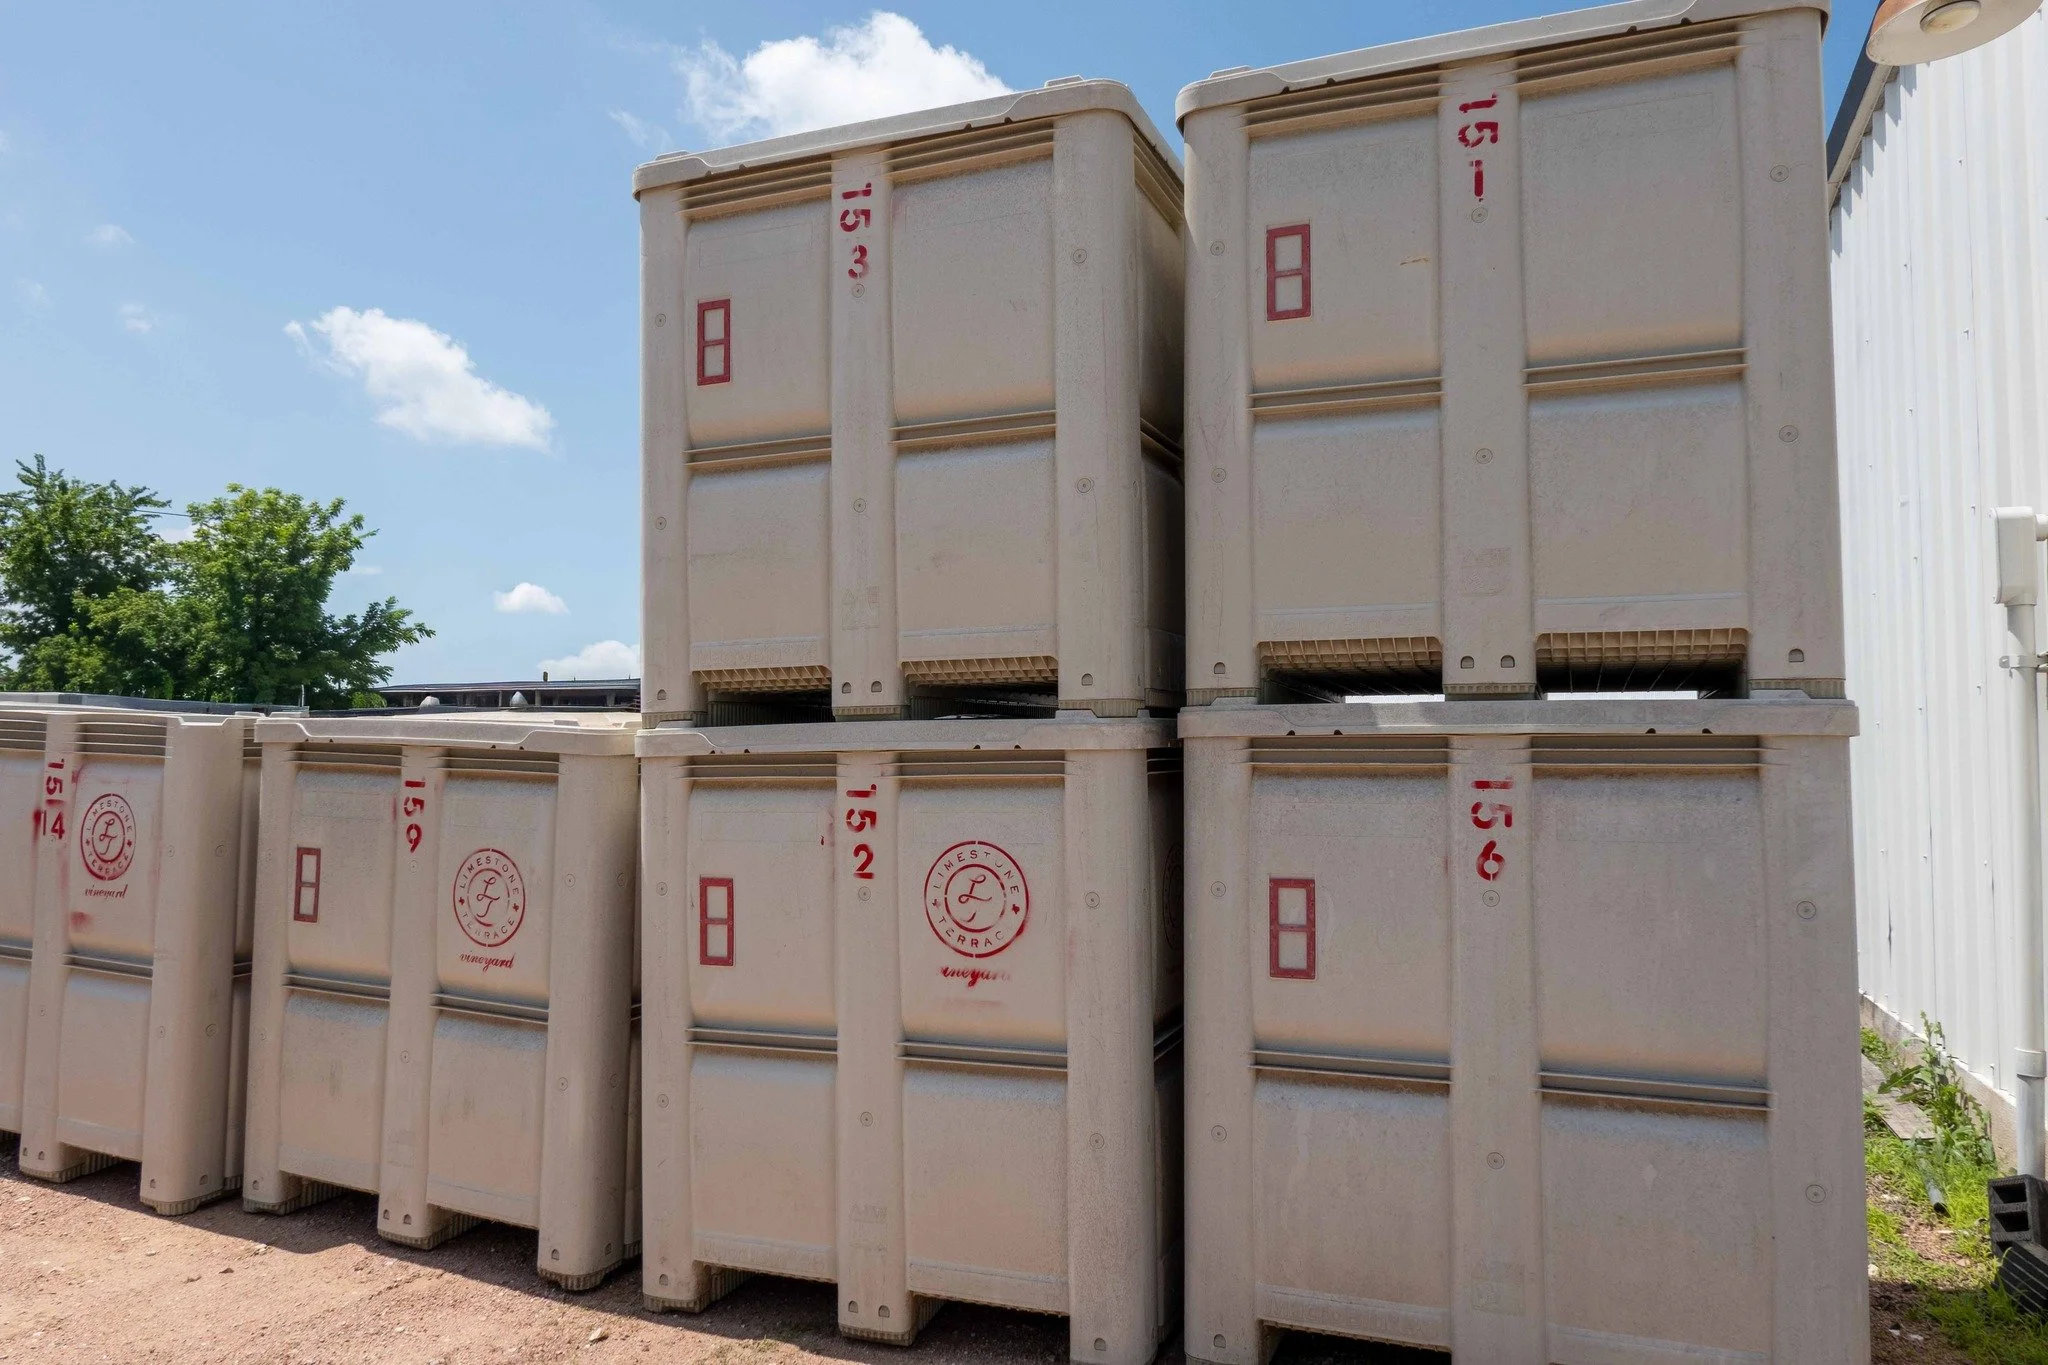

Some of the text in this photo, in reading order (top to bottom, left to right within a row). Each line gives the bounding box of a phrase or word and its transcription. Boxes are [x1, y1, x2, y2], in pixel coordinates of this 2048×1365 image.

[86, 799, 133, 833] LMESTONE
[84, 882, 129, 900] vineyard
[459, 855, 520, 895] LIMESTONE
[937, 915, 1006, 949] TERRAC
[459, 949, 516, 973] vineyard
